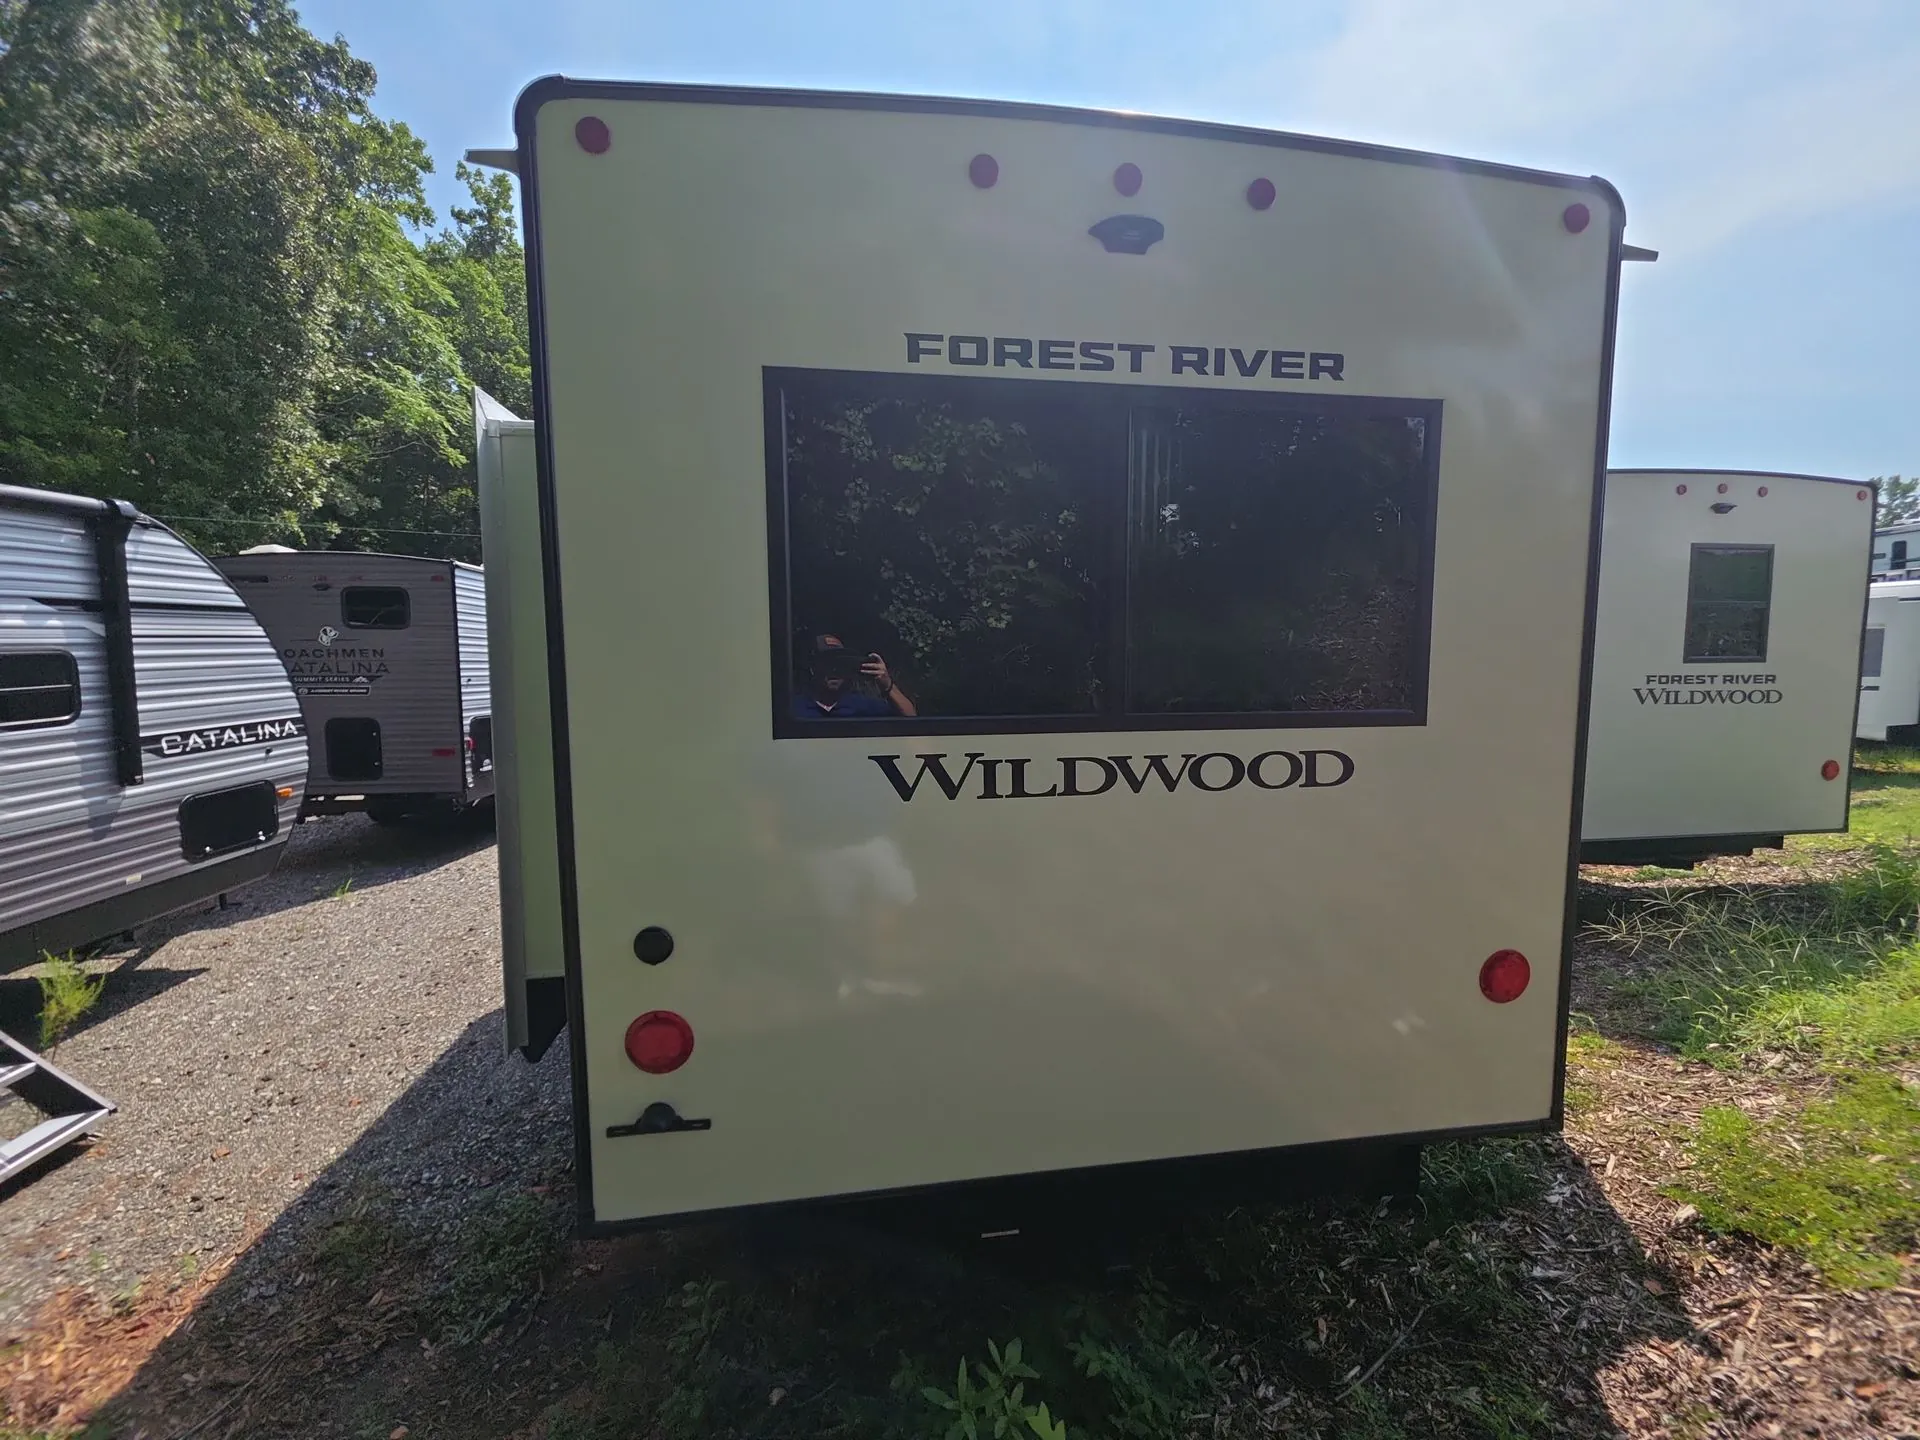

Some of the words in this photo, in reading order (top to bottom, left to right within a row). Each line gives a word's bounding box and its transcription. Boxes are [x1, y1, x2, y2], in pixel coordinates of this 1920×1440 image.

[903, 332, 1156, 373] FOREST
[1168, 345, 1345, 382] RIVER
[283, 648, 385, 659] OACHMEN
[290, 661, 391, 674] ATALINA
[1645, 674, 1718, 685] FOREST
[1722, 674, 1777, 685] RIVER
[1632, 688, 1784, 705] WILDWOOD
[160, 720, 299, 755] CATALINA
[867, 749, 1355, 802] WILDWOOD
